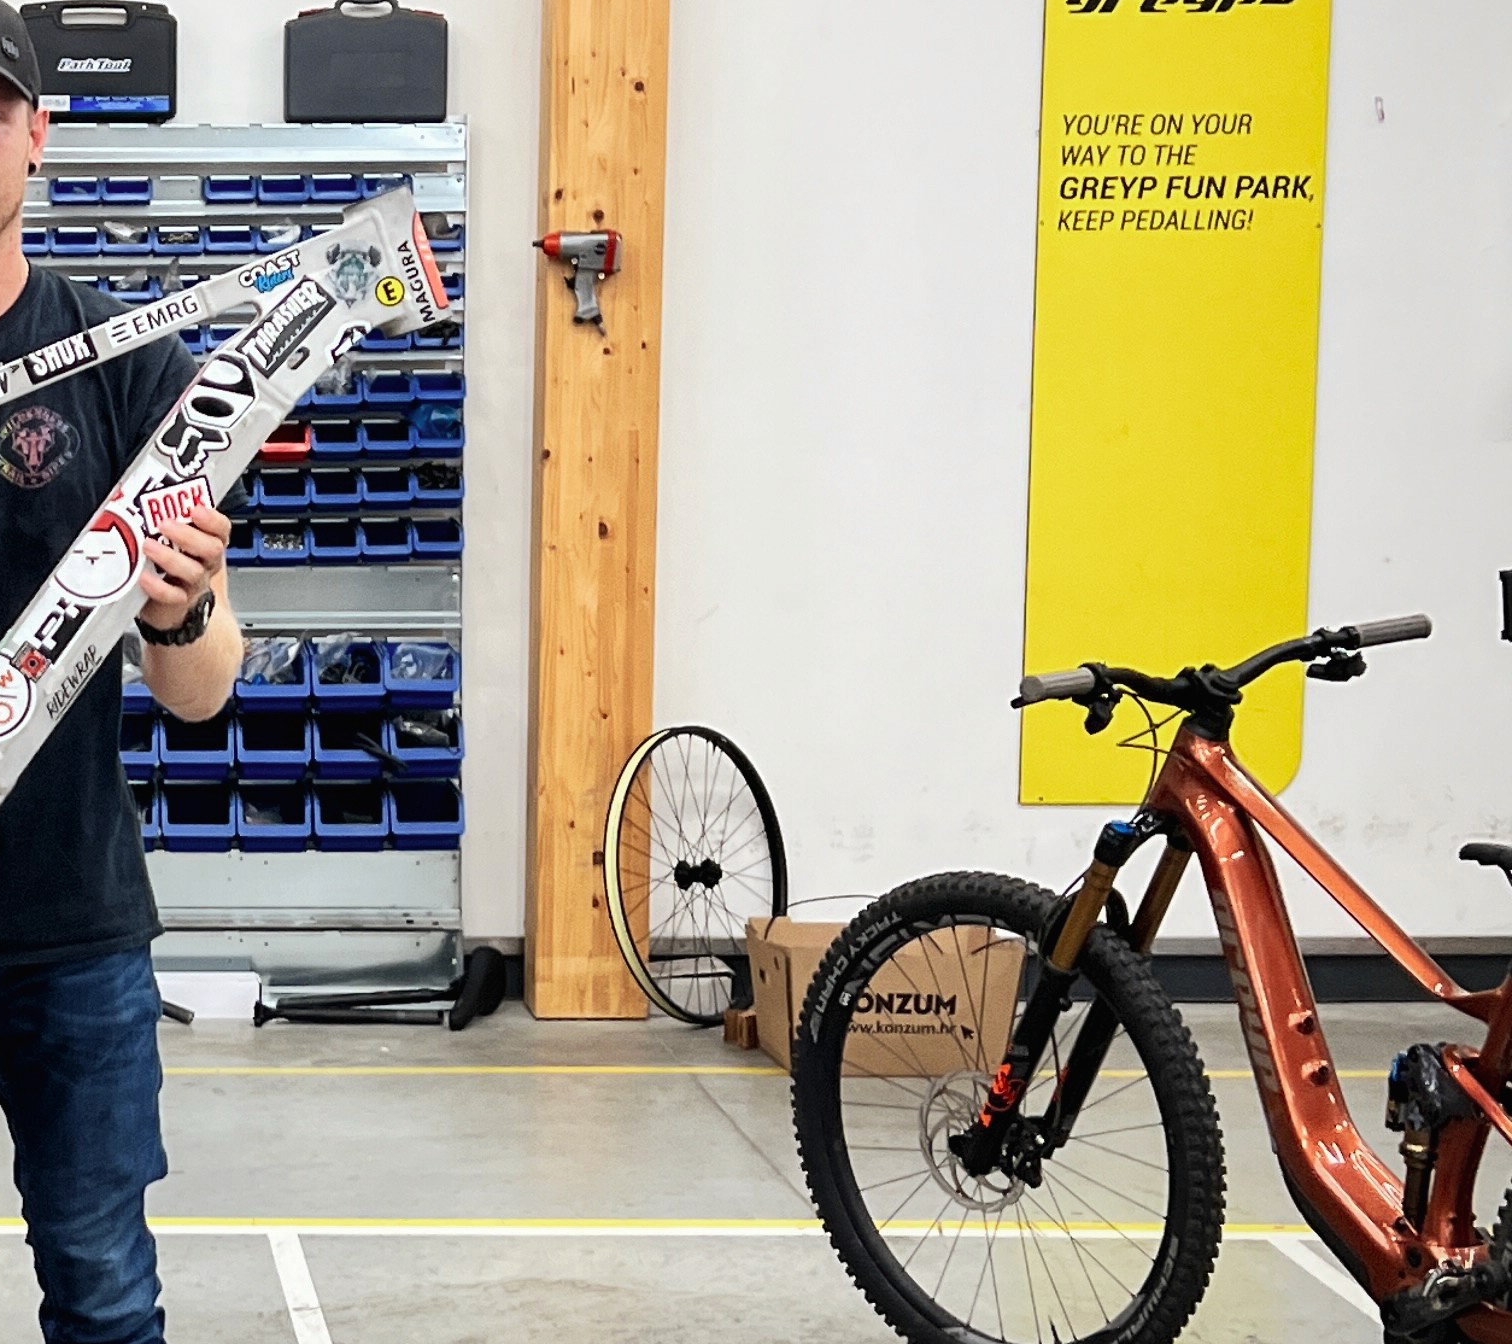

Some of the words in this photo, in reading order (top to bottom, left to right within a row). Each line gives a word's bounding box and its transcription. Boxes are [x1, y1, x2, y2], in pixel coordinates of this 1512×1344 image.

[58, 58, 94, 72] Park
[96, 58, 132, 72] Tool
[1063, 113, 1145, 135] YOU'RE
[1150, 113, 1184, 135] ON
[1192, 113, 1253, 135] YOUR
[1061, 144, 1111, 166] WAY
[1118, 144, 1146, 166] TO
[1155, 144, 1198, 166] THE
[1059, 175, 1158, 199] GREYP
[1165, 175, 1227, 199] FUN
[1234, 175, 1314, 201] PARK,
[1057, 209, 1115, 231] KEEP
[1120, 209, 1254, 231] PEDALLING!
[239, 250, 300, 288] COAST
[397, 240, 436, 323] MAGURA
[132, 295, 199, 335] EMRG
[241, 280, 329, 369] THRASHER
[147, 484, 206, 528] ROCK
[855, 992, 957, 1016] ONZUM
[847, 1020, 957, 1035] ww.konzum.hr
